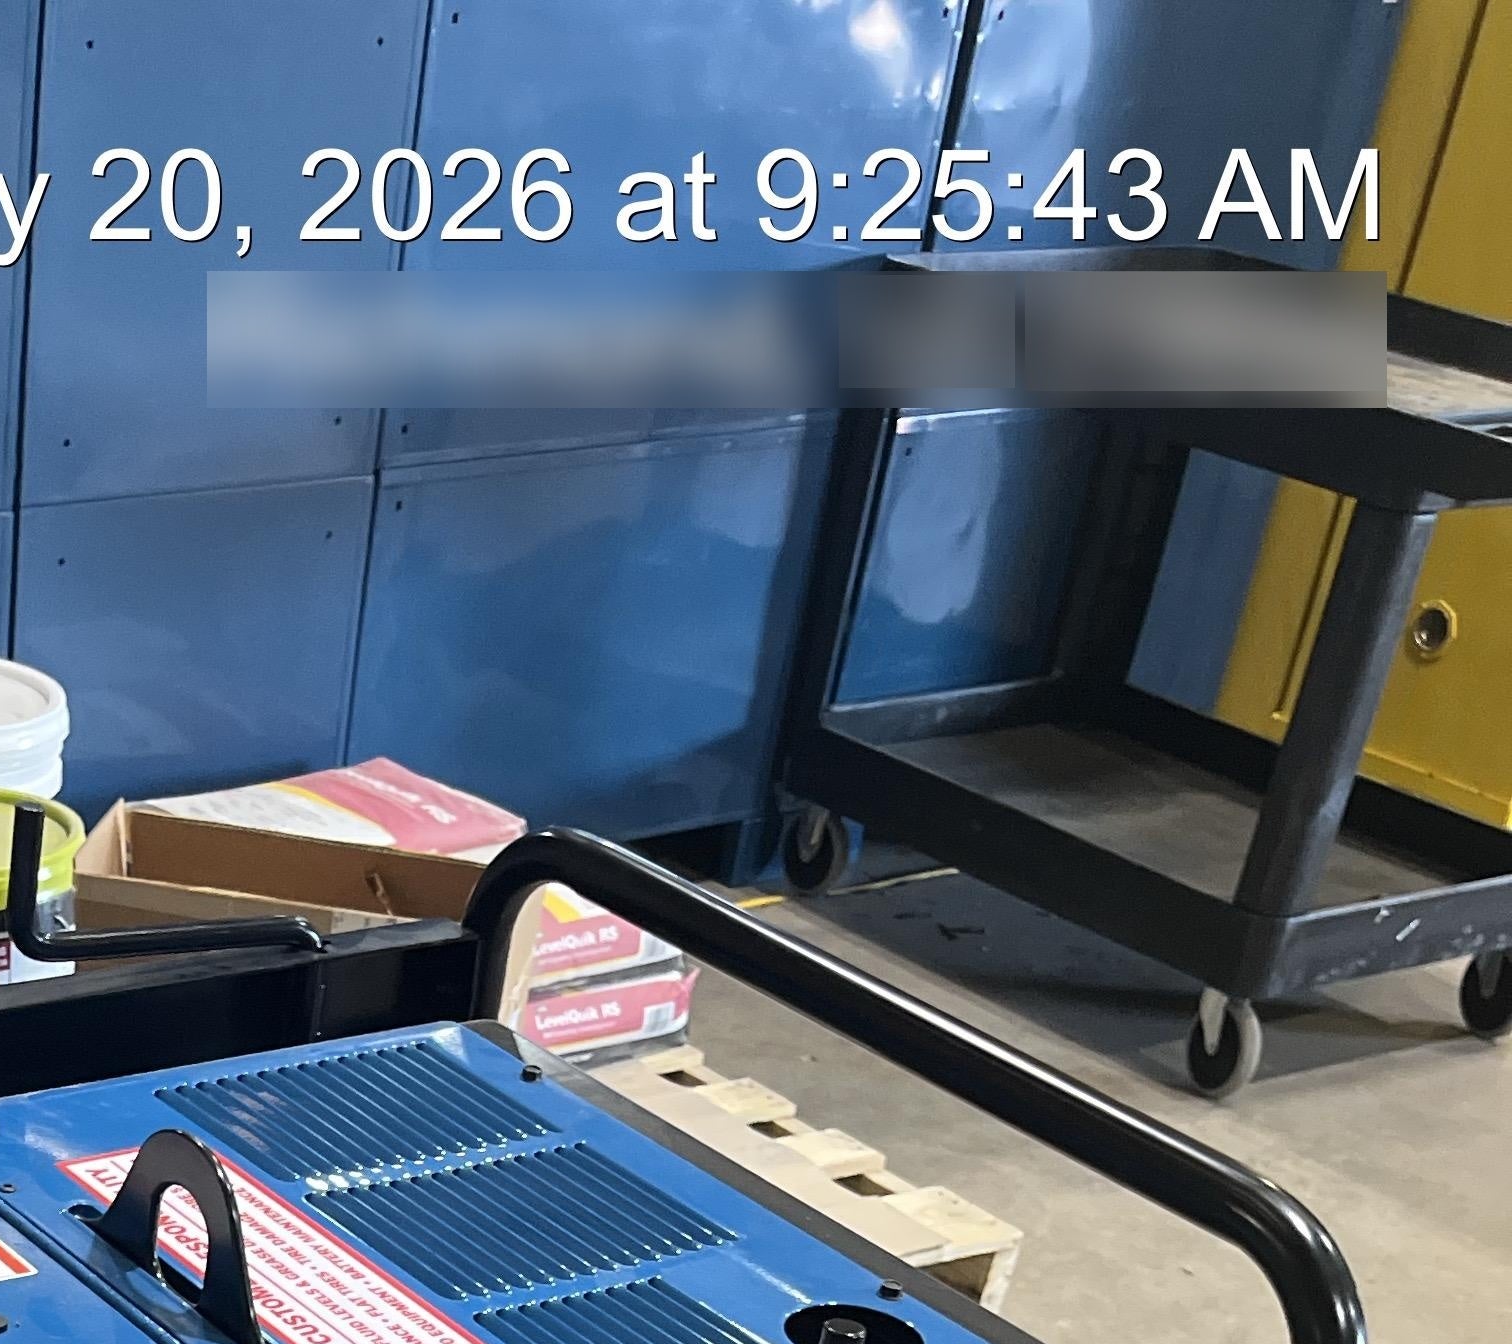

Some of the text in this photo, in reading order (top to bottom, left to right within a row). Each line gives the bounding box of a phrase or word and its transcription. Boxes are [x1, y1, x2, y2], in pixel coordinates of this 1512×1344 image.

[599, 926, 619, 943] RS
[534, 1002, 621, 1030] LevelQuik RS
[250, 1248, 301, 1279] GREASE
[280, 1246, 314, 1265] TIRE
[308, 1243, 366, 1279] BATTERY
[313, 1270, 354, 1295] TIRES
[303, 1288, 355, 1320] LEVELS
[347, 1296, 384, 1317] FLAT
[367, 1286, 445, 1336] EQUIPMENT
